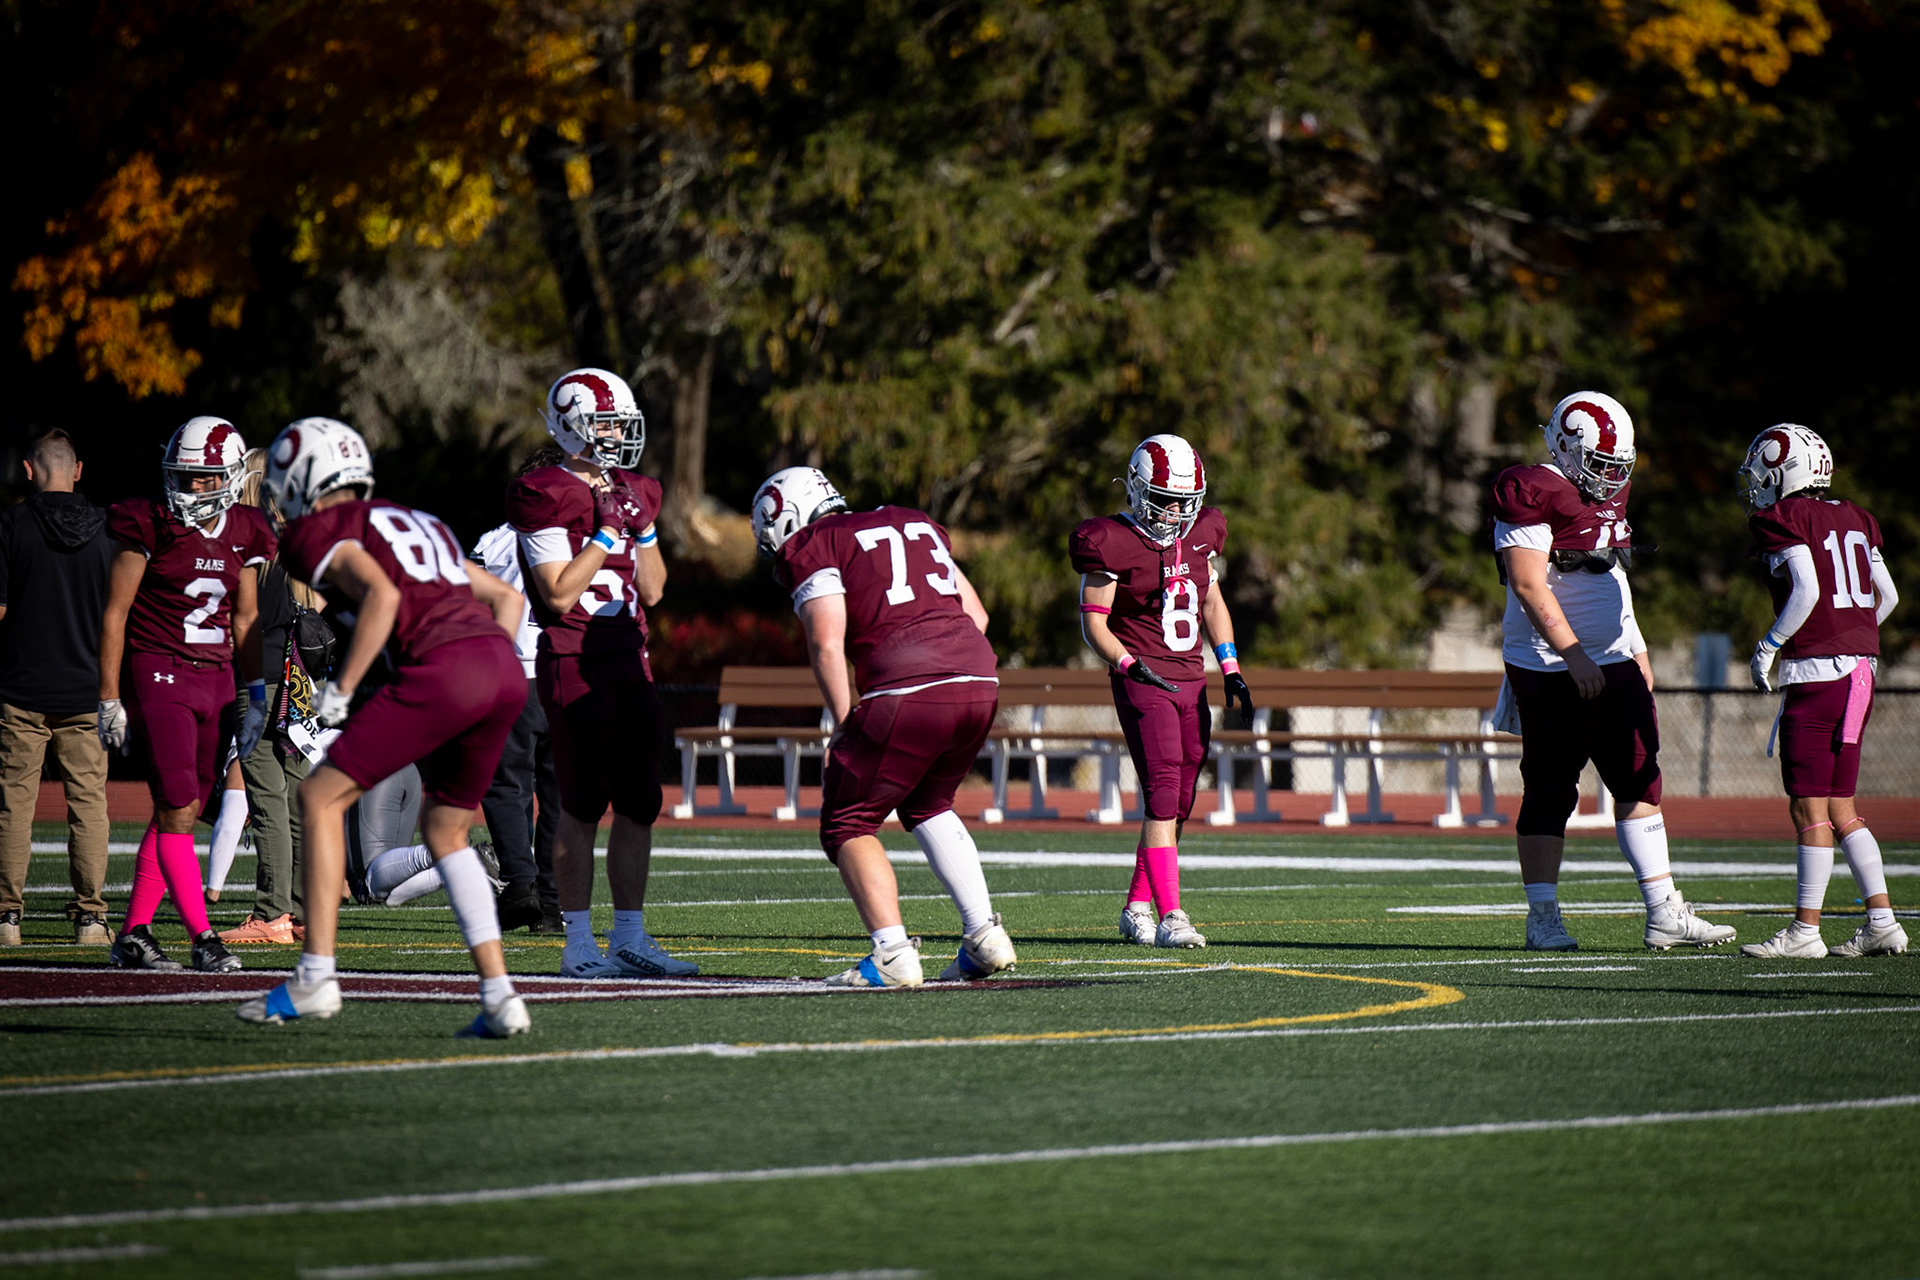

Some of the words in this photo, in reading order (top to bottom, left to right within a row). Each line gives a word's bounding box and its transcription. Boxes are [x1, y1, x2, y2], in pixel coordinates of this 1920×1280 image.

[194, 557, 225, 572] RAMS
[369, 506, 471, 586] 80
[854, 521, 958, 606] 73
[1823, 530, 1875, 609] 10
[183, 577, 228, 644] 2
[1162, 578, 1199, 652] 8
